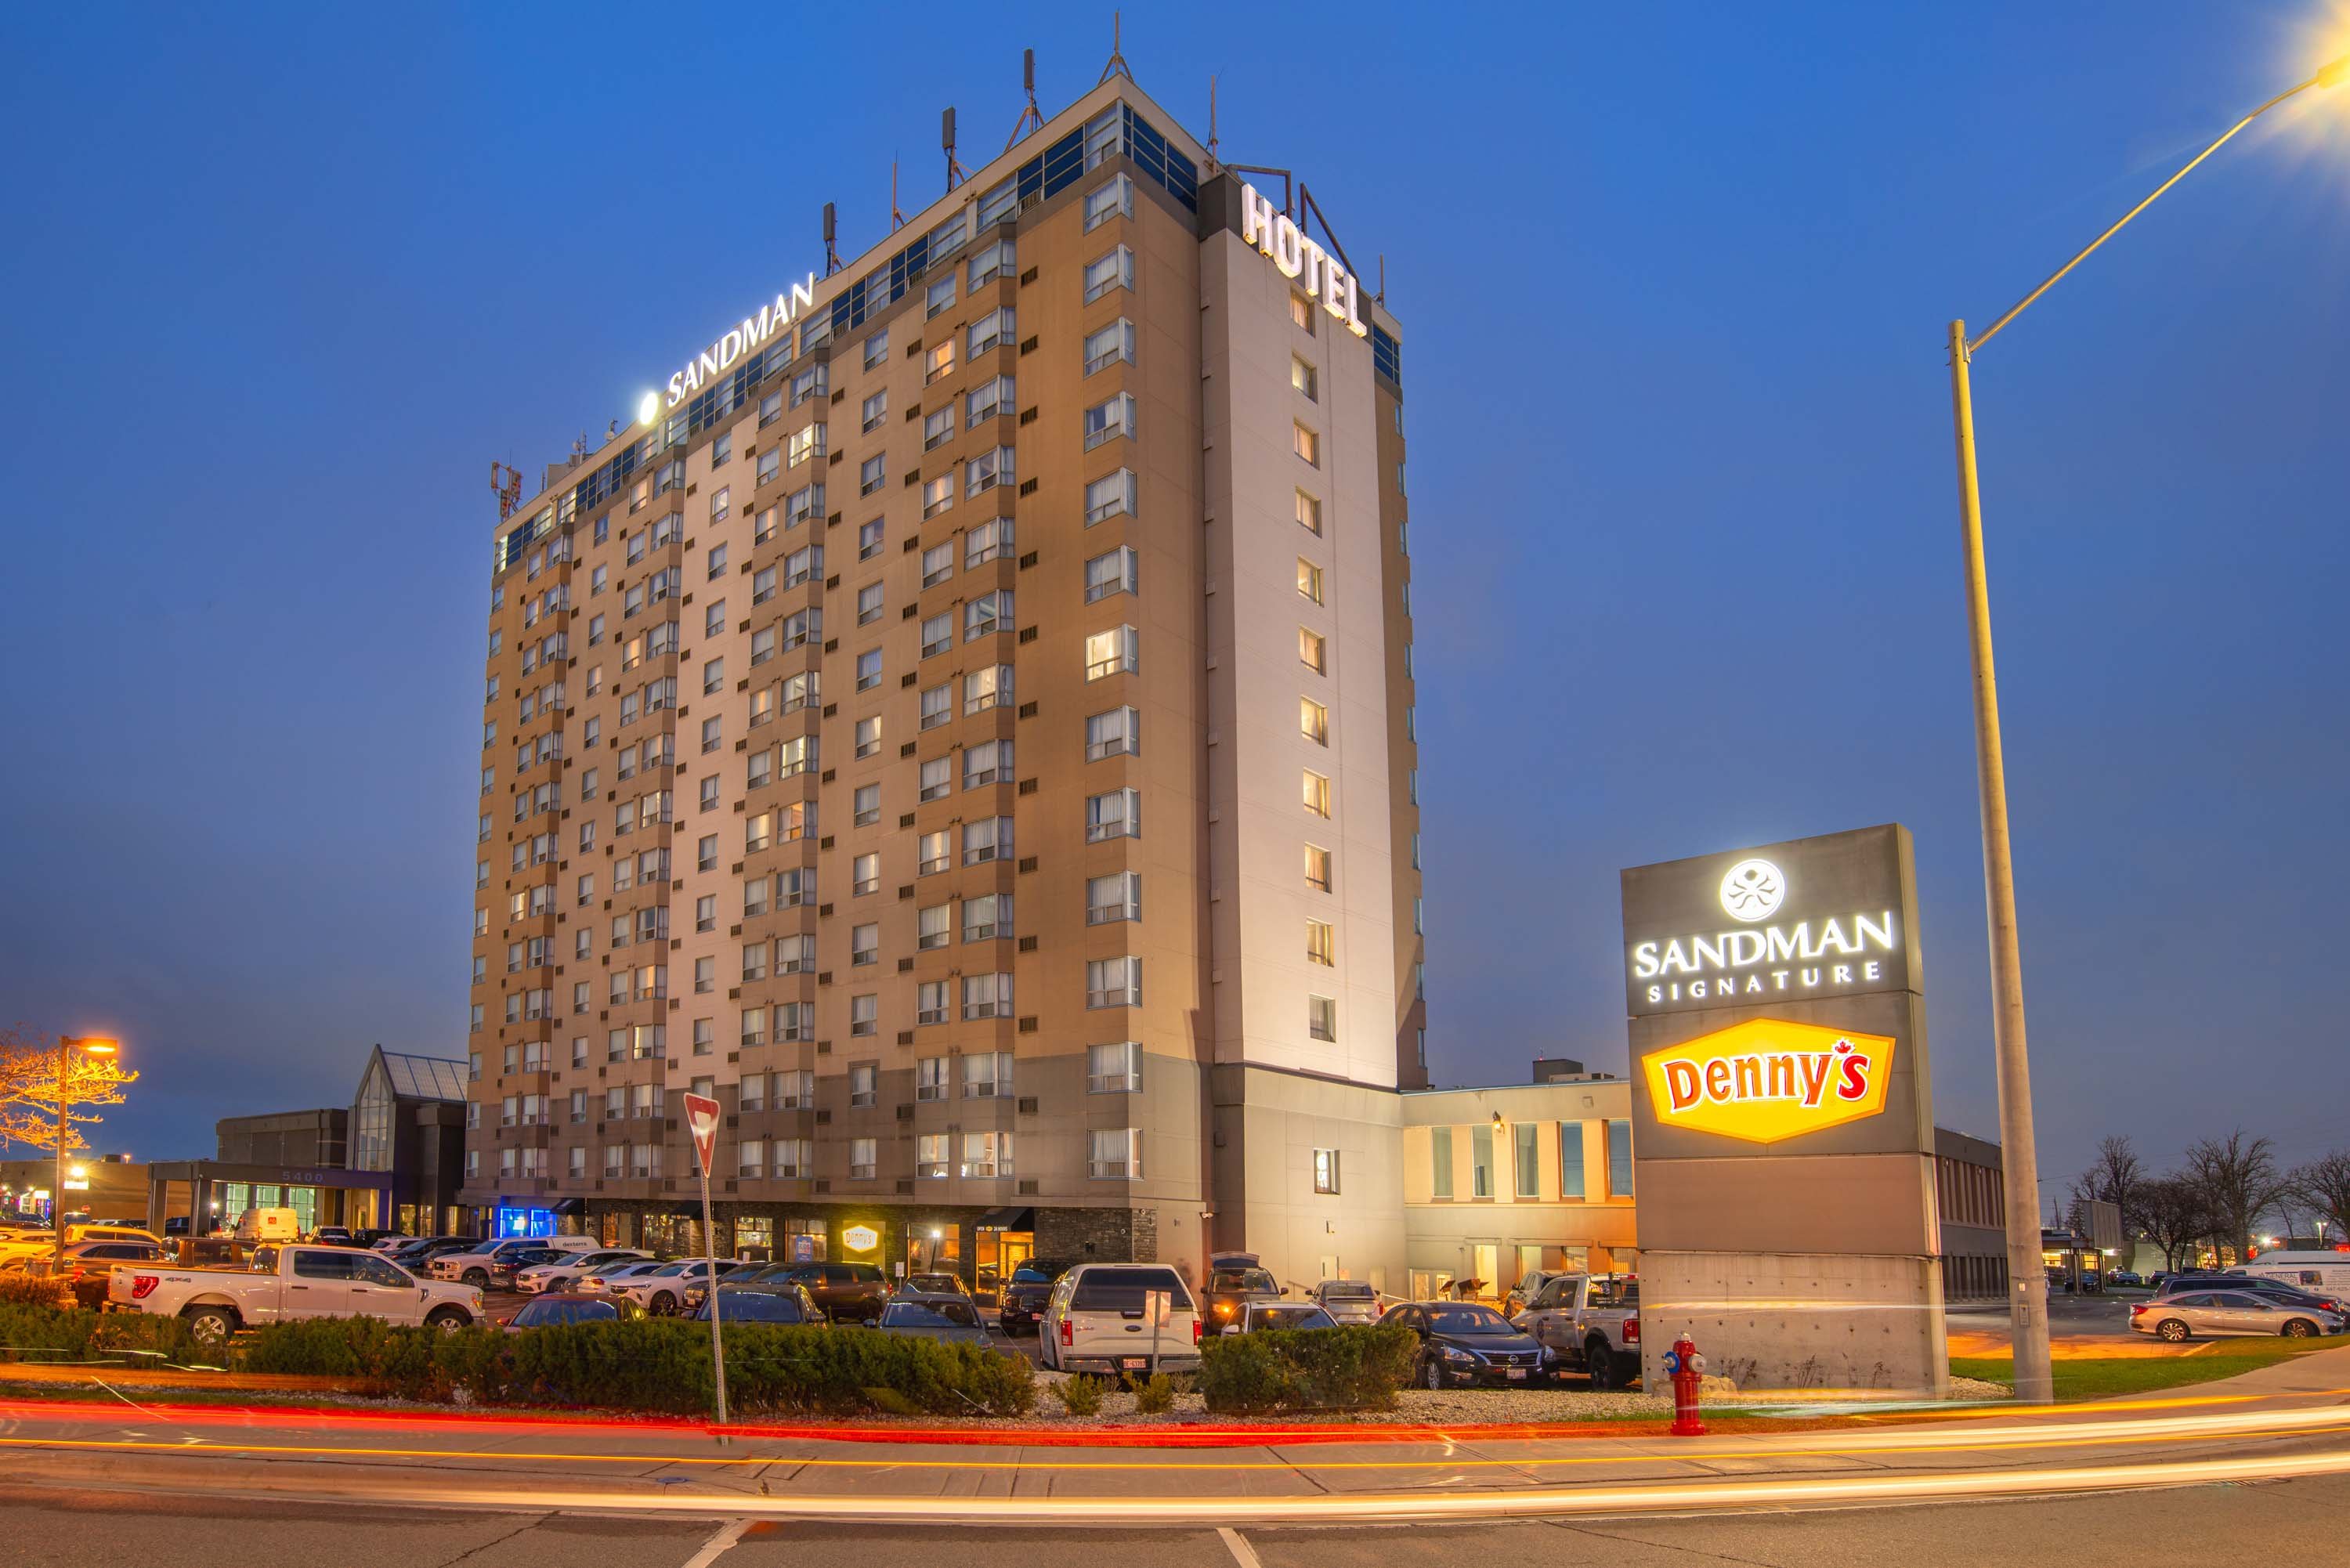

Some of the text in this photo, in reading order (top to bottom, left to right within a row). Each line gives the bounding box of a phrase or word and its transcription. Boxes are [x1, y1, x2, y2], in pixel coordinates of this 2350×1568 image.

[1242, 183, 1367, 338] HOTEL
[667, 272, 815, 407] SANDMAN
[1635, 911, 1893, 978] SANDMAN
[1648, 961, 1881, 1003] SIGNATURE
[283, 1172, 324, 1183] 5400
